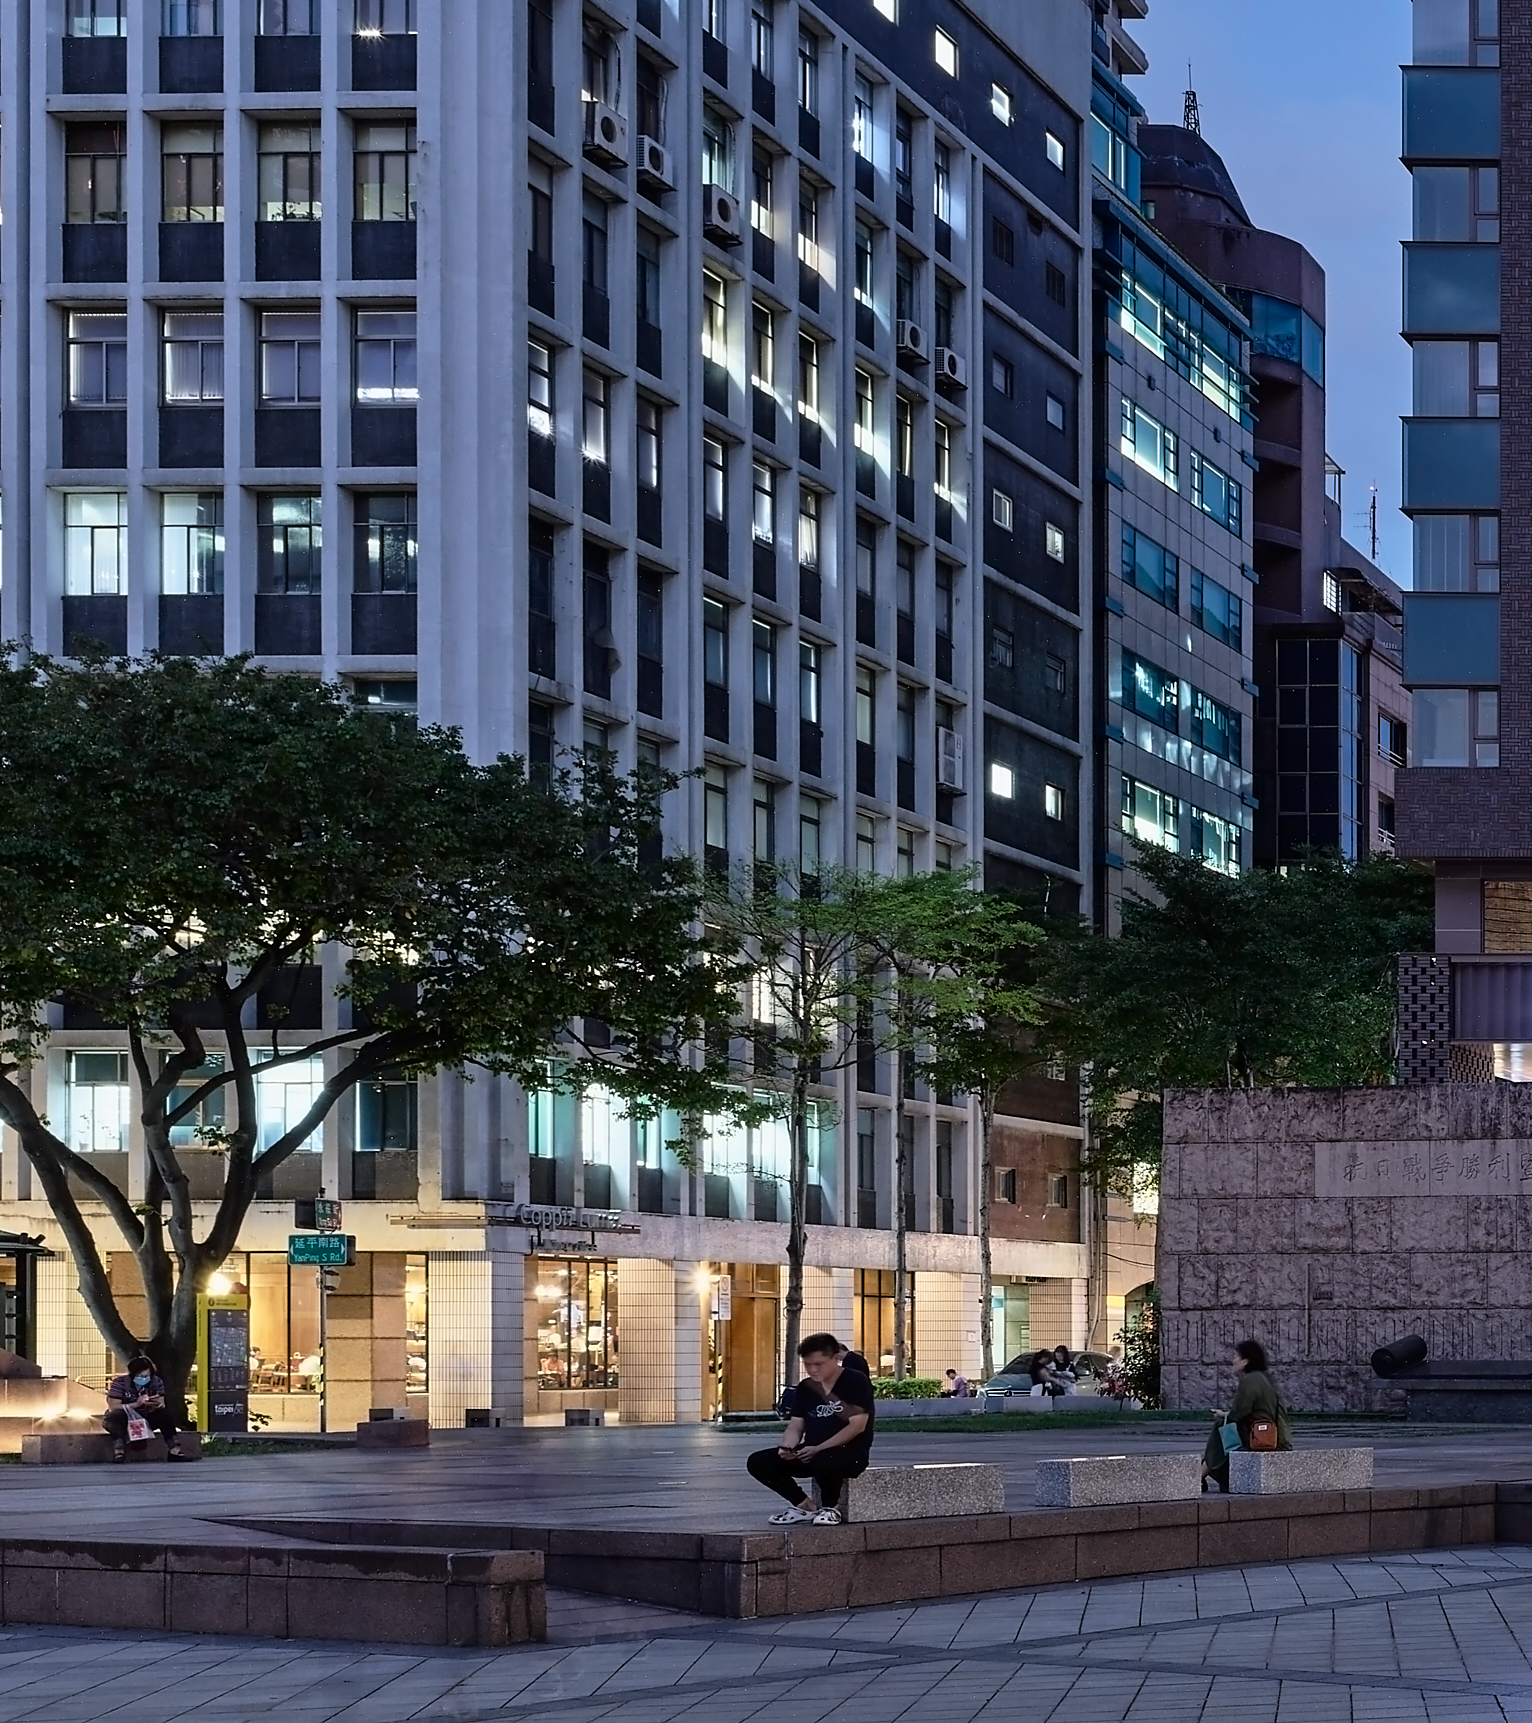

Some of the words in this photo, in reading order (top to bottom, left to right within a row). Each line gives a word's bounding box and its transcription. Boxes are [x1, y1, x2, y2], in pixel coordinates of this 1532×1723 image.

[294, 1237, 340, 1249] 延平南路
[293, 1253, 320, 1263] YanPing
[321, 1253, 328, 1262] S
[330, 1252, 342, 1262] Rd.
